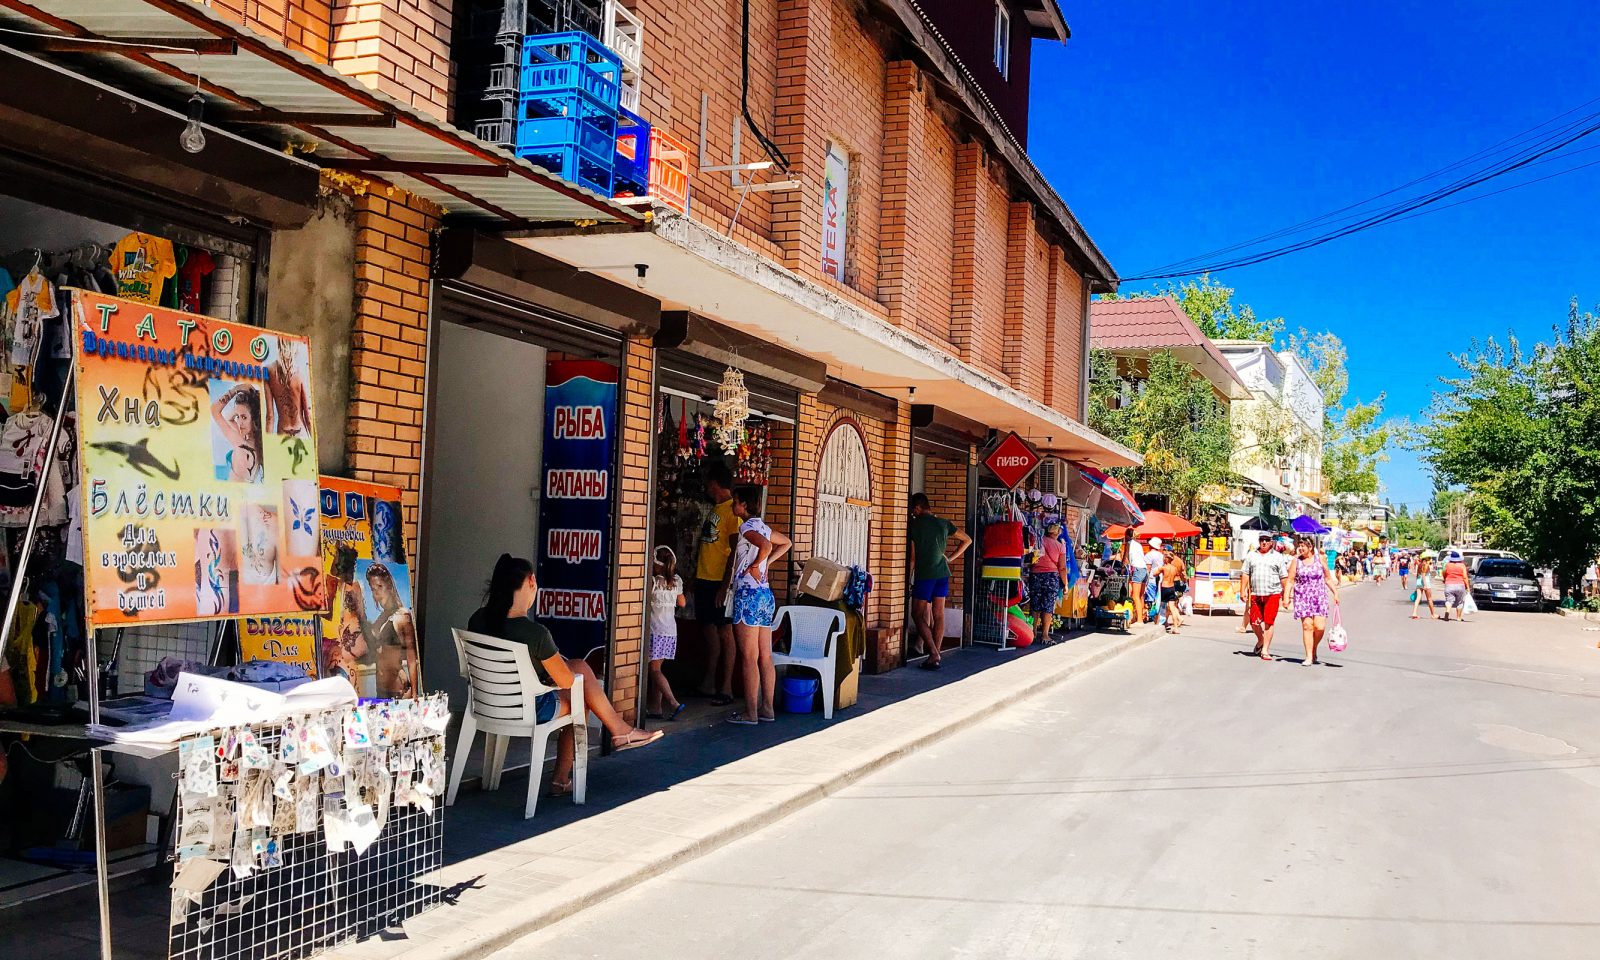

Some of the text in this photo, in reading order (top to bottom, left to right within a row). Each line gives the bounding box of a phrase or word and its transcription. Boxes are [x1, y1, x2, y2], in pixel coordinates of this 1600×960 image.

[82, 330, 270, 381] Временные татуировки
[96, 385, 162, 429] Хна
[554, 406, 605, 439] РЫБА
[996, 456, 1029, 467] ПИВО
[90, 479, 229, 519] Блёстки
[547, 470, 607, 499] РАПАНЫ
[121, 524, 156, 547] Для
[548, 529, 601, 563] МИДИИ
[101, 547, 177, 571] взрослых
[135, 574, 148, 590] и
[116, 591, 166, 611] детей
[537, 588, 606, 620] КРЕВЕТКА
[263, 639, 298, 658] Для
